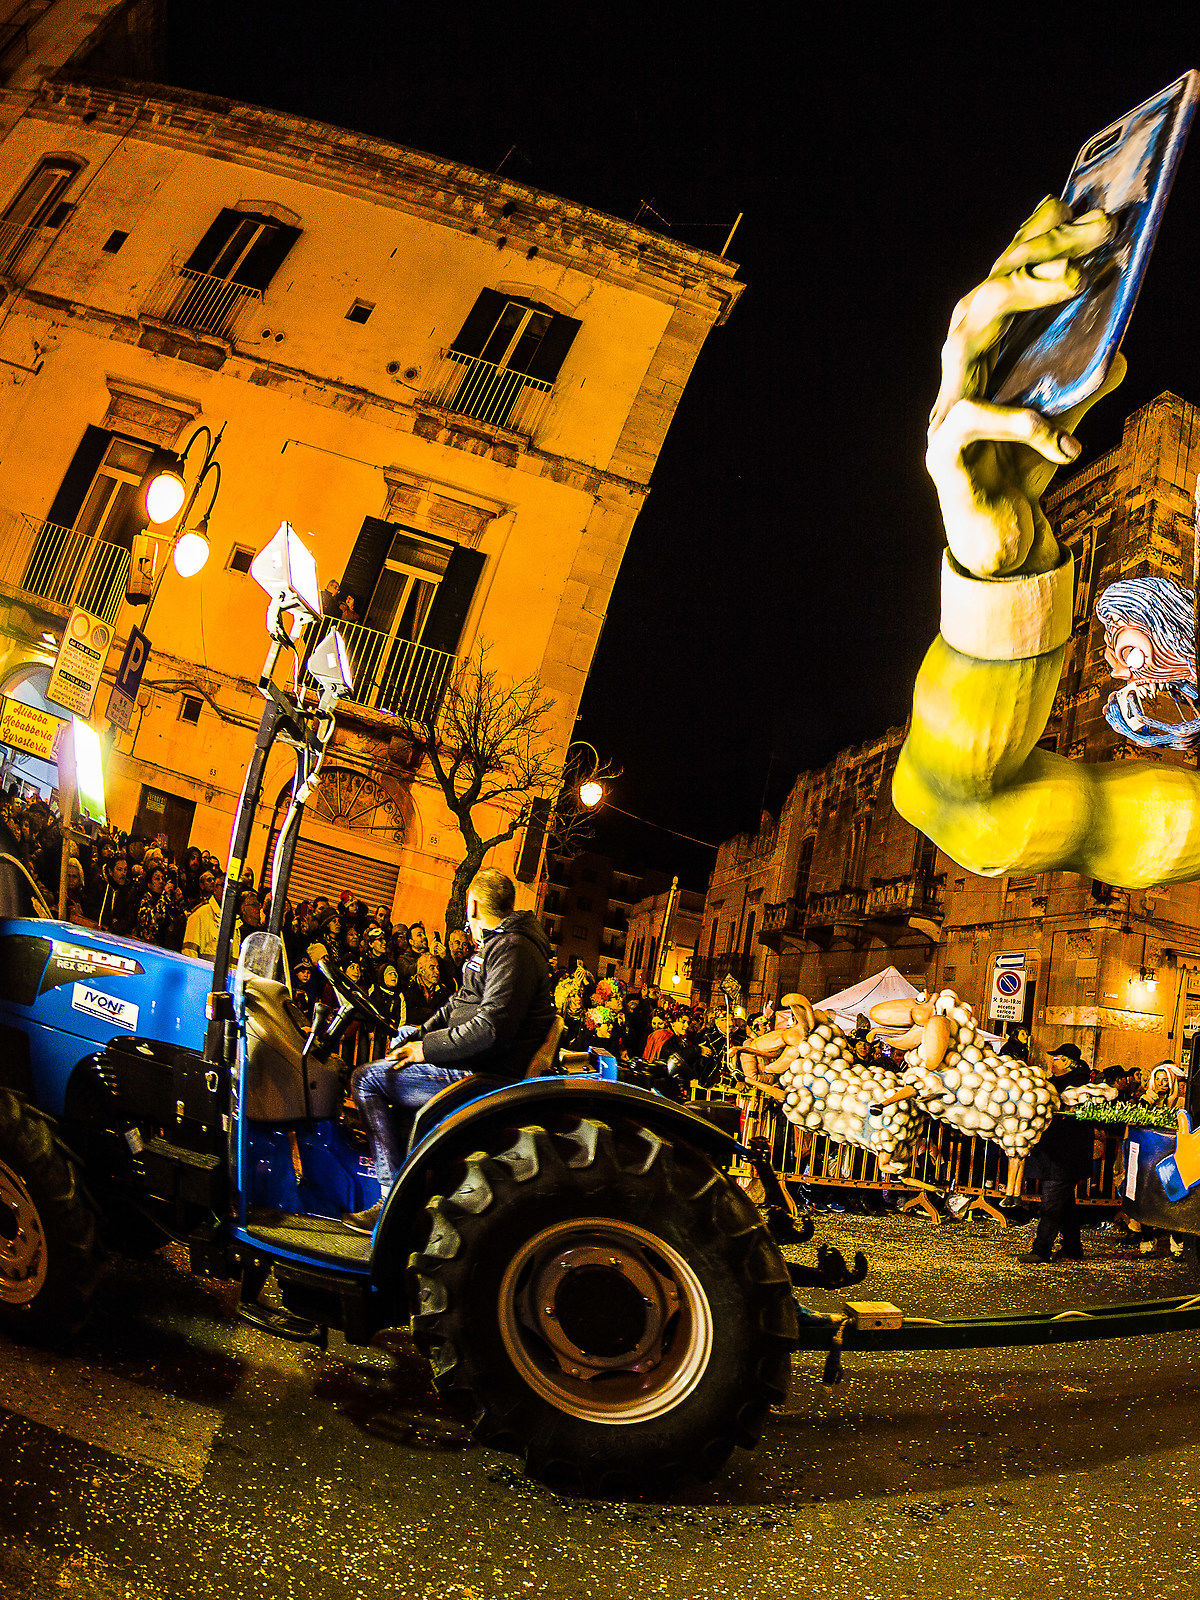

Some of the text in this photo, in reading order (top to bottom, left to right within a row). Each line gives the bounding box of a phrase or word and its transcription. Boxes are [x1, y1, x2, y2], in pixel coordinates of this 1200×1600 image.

[122, 636, 144, 685] P
[13, 704, 48, 725] Alibaba
[3, 714, 53, 742] Kebabberia
[56, 959, 77, 971] REX
